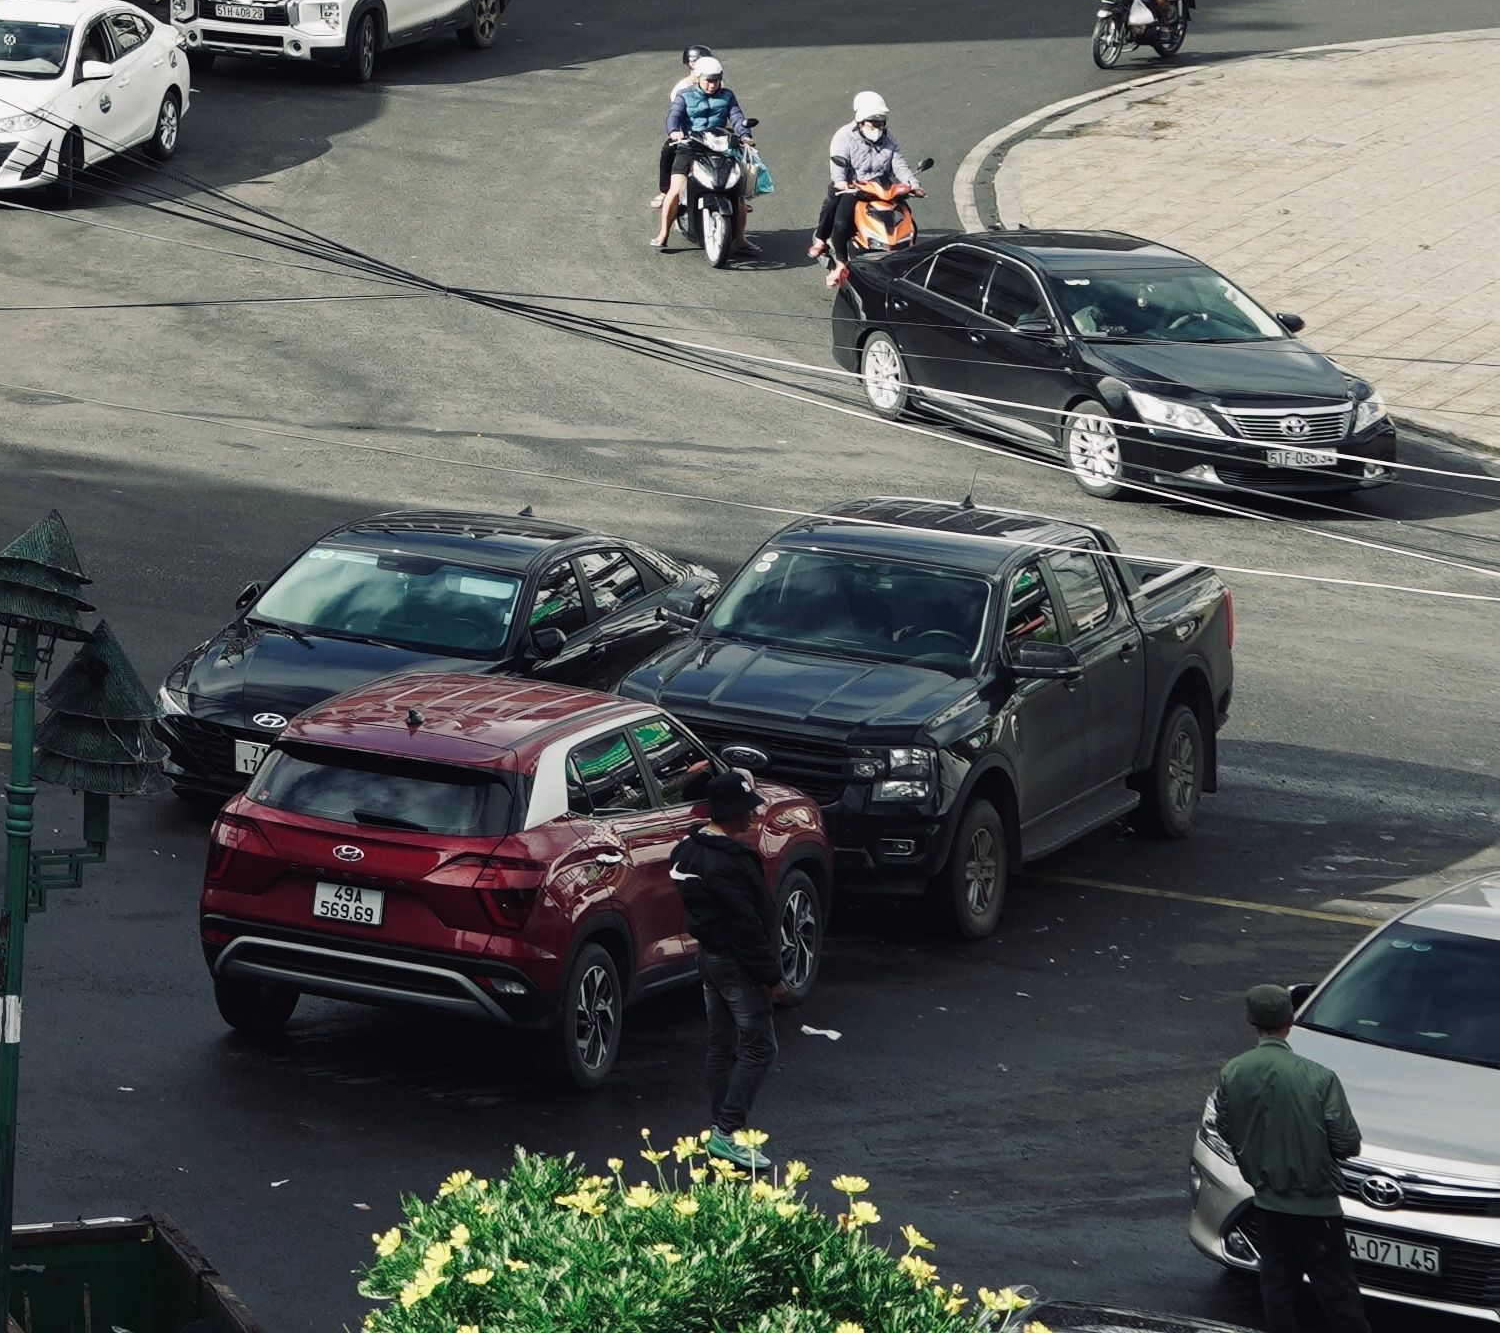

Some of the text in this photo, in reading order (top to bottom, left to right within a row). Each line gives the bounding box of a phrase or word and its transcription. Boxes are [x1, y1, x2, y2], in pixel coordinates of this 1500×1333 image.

[332, 884, 363, 904] 49A
[319, 899, 375, 922] 569.69
[1350, 1233, 1438, 1274] A-071.45
